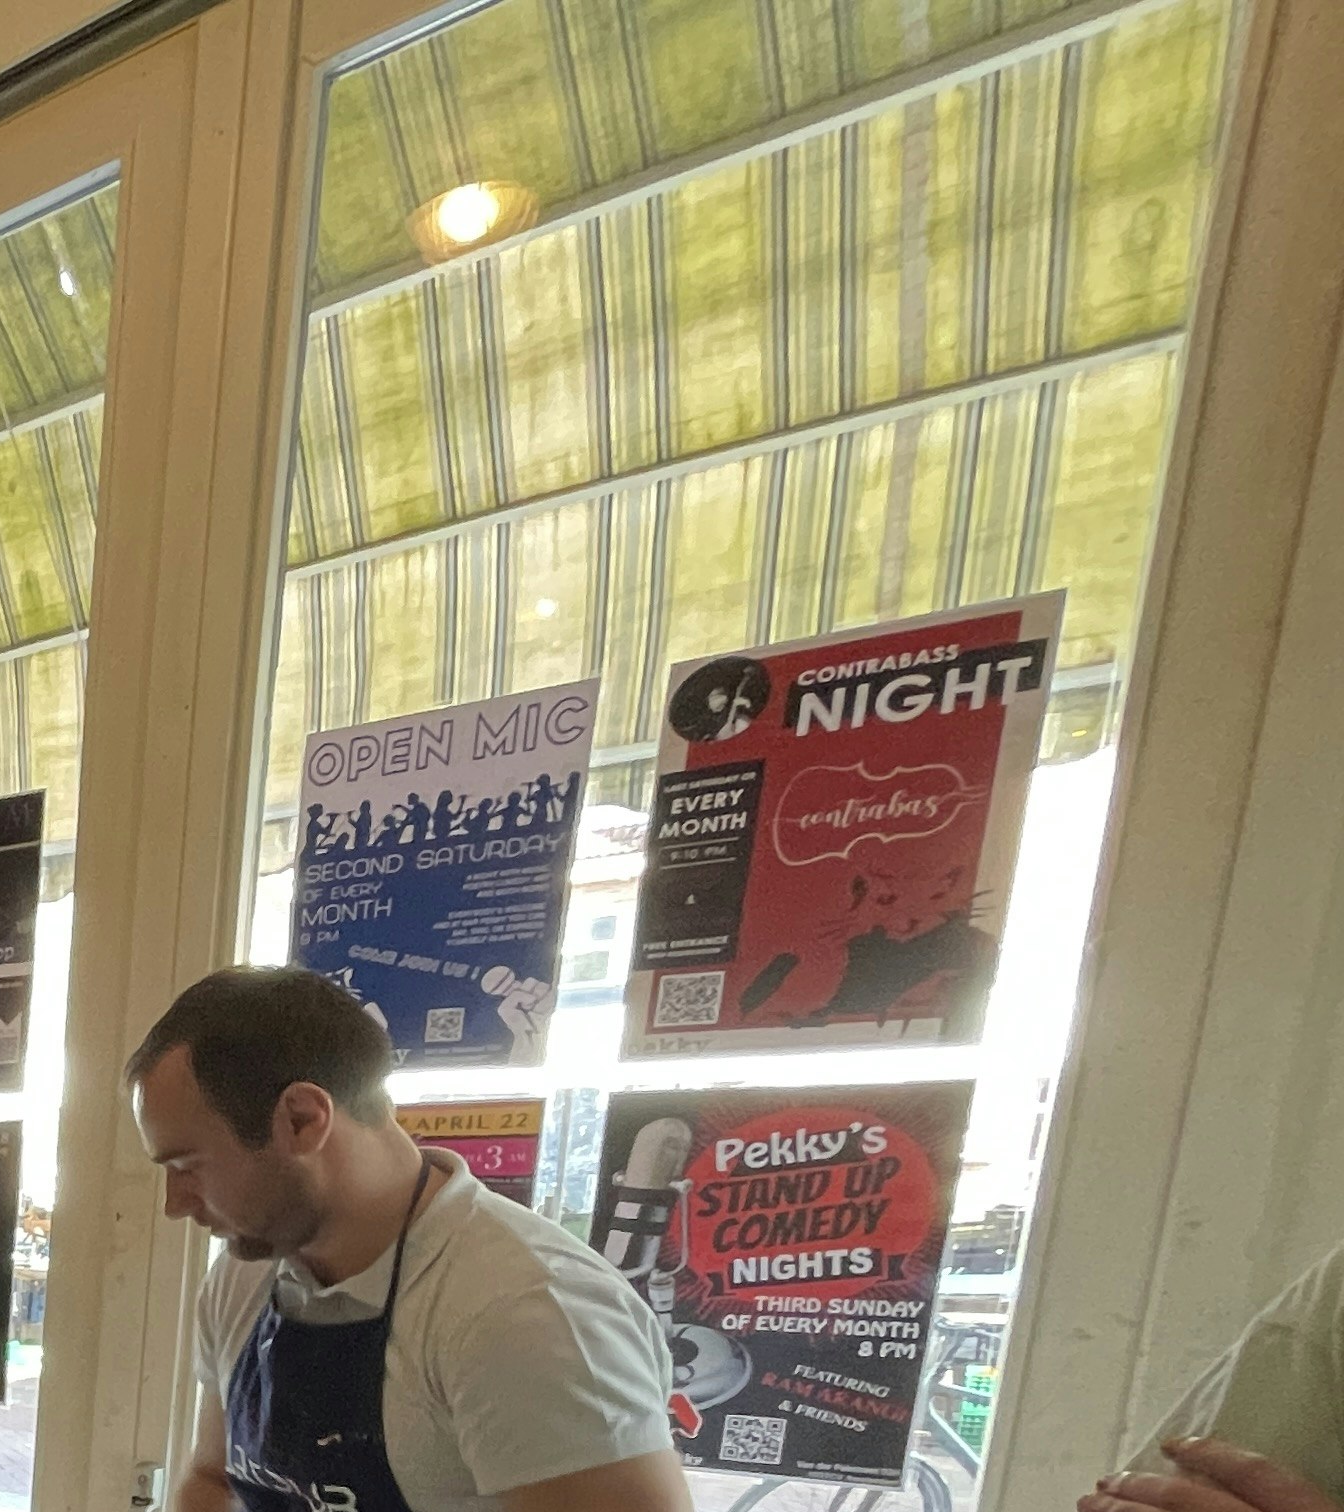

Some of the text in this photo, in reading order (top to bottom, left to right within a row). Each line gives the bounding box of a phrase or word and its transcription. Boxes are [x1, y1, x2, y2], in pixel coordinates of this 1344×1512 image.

[797, 643, 962, 687] CONTRABASS
[795, 655, 1033, 737] NIGHT
[307, 695, 590, 788] OPEN MIC
[670, 788, 745, 815] EVERY
[658, 811, 748, 839] MONTH
[304, 834, 564, 885] SECOND SATURDAY
[330, 881, 384, 901] EVERY
[300, 897, 393, 928] MONTH
[416, 1112, 529, 1132] APRIL 22
[484, 1144, 504, 1170] 3
[715, 1121, 888, 1172] Pekky's
[696, 1156, 903, 1218] STAND UP
[713, 1198, 893, 1253] COMEDY
[732, 1246, 874, 1284] NIGHTS
[754, 1295, 926, 1319] THIRD SUNDAY
[721, 1313, 921, 1340] OF EVERY MONTH
[857, 1340, 917, 1360] 8 PM
[793, 1363, 891, 1398] FEATURING
[778, 1399, 793, 1413] &
[794, 1403, 869, 1433] FRIENDS
